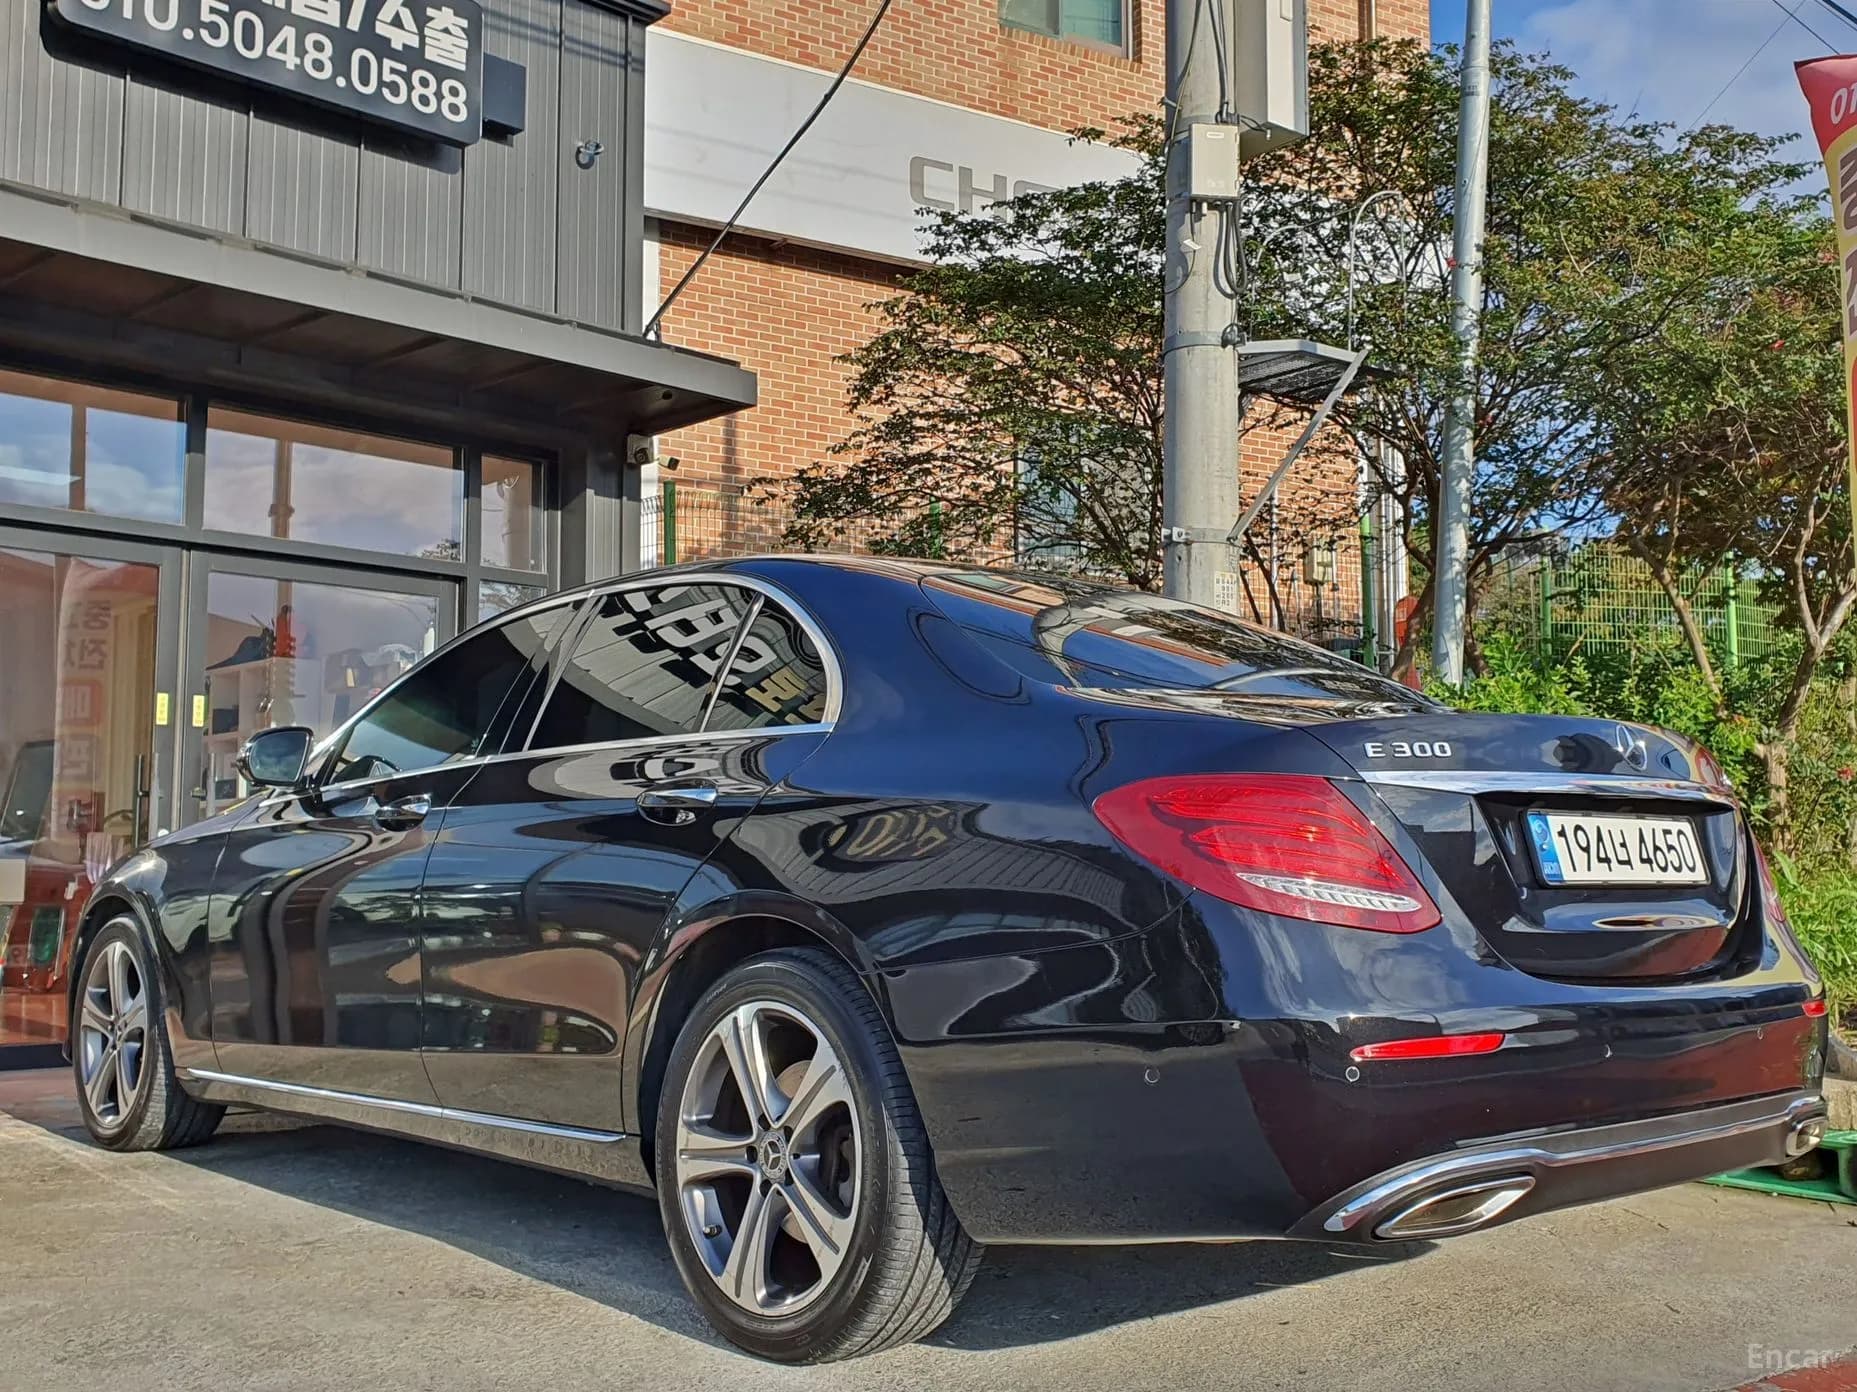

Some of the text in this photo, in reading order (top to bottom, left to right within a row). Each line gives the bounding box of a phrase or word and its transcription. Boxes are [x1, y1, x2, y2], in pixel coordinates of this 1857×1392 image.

[81, 0, 469, 123] 0.5048.0588
[1364, 741, 1452, 758] E 300
[1557, 823, 1696, 873] 194너 4650
